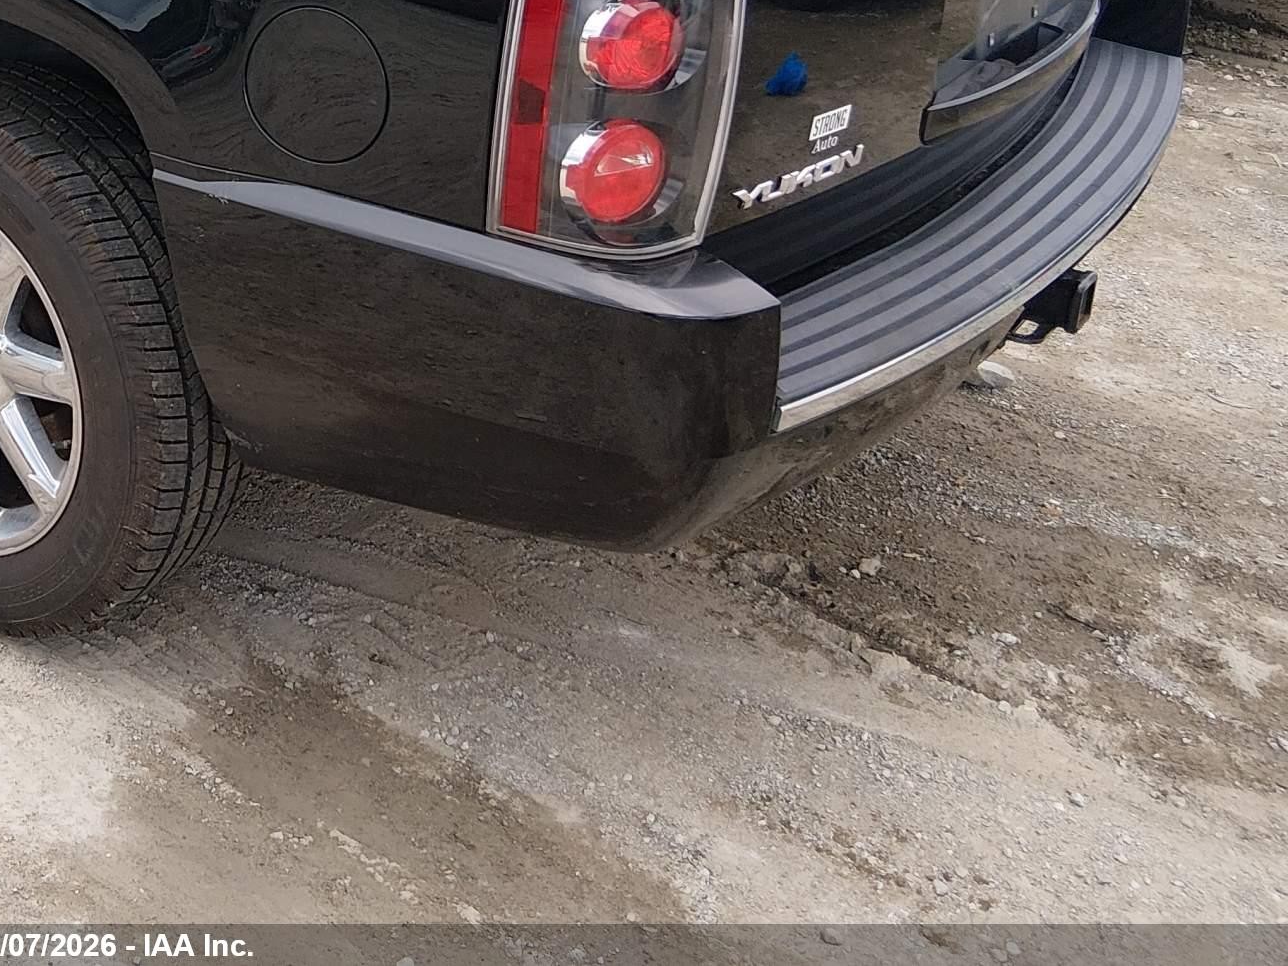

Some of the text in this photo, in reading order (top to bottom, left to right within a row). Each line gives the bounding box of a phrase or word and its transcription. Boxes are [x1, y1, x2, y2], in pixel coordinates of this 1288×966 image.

[813, 108, 846, 137] STRONG
[811, 136, 839, 154] Auto
[732, 144, 865, 210] YUKON
